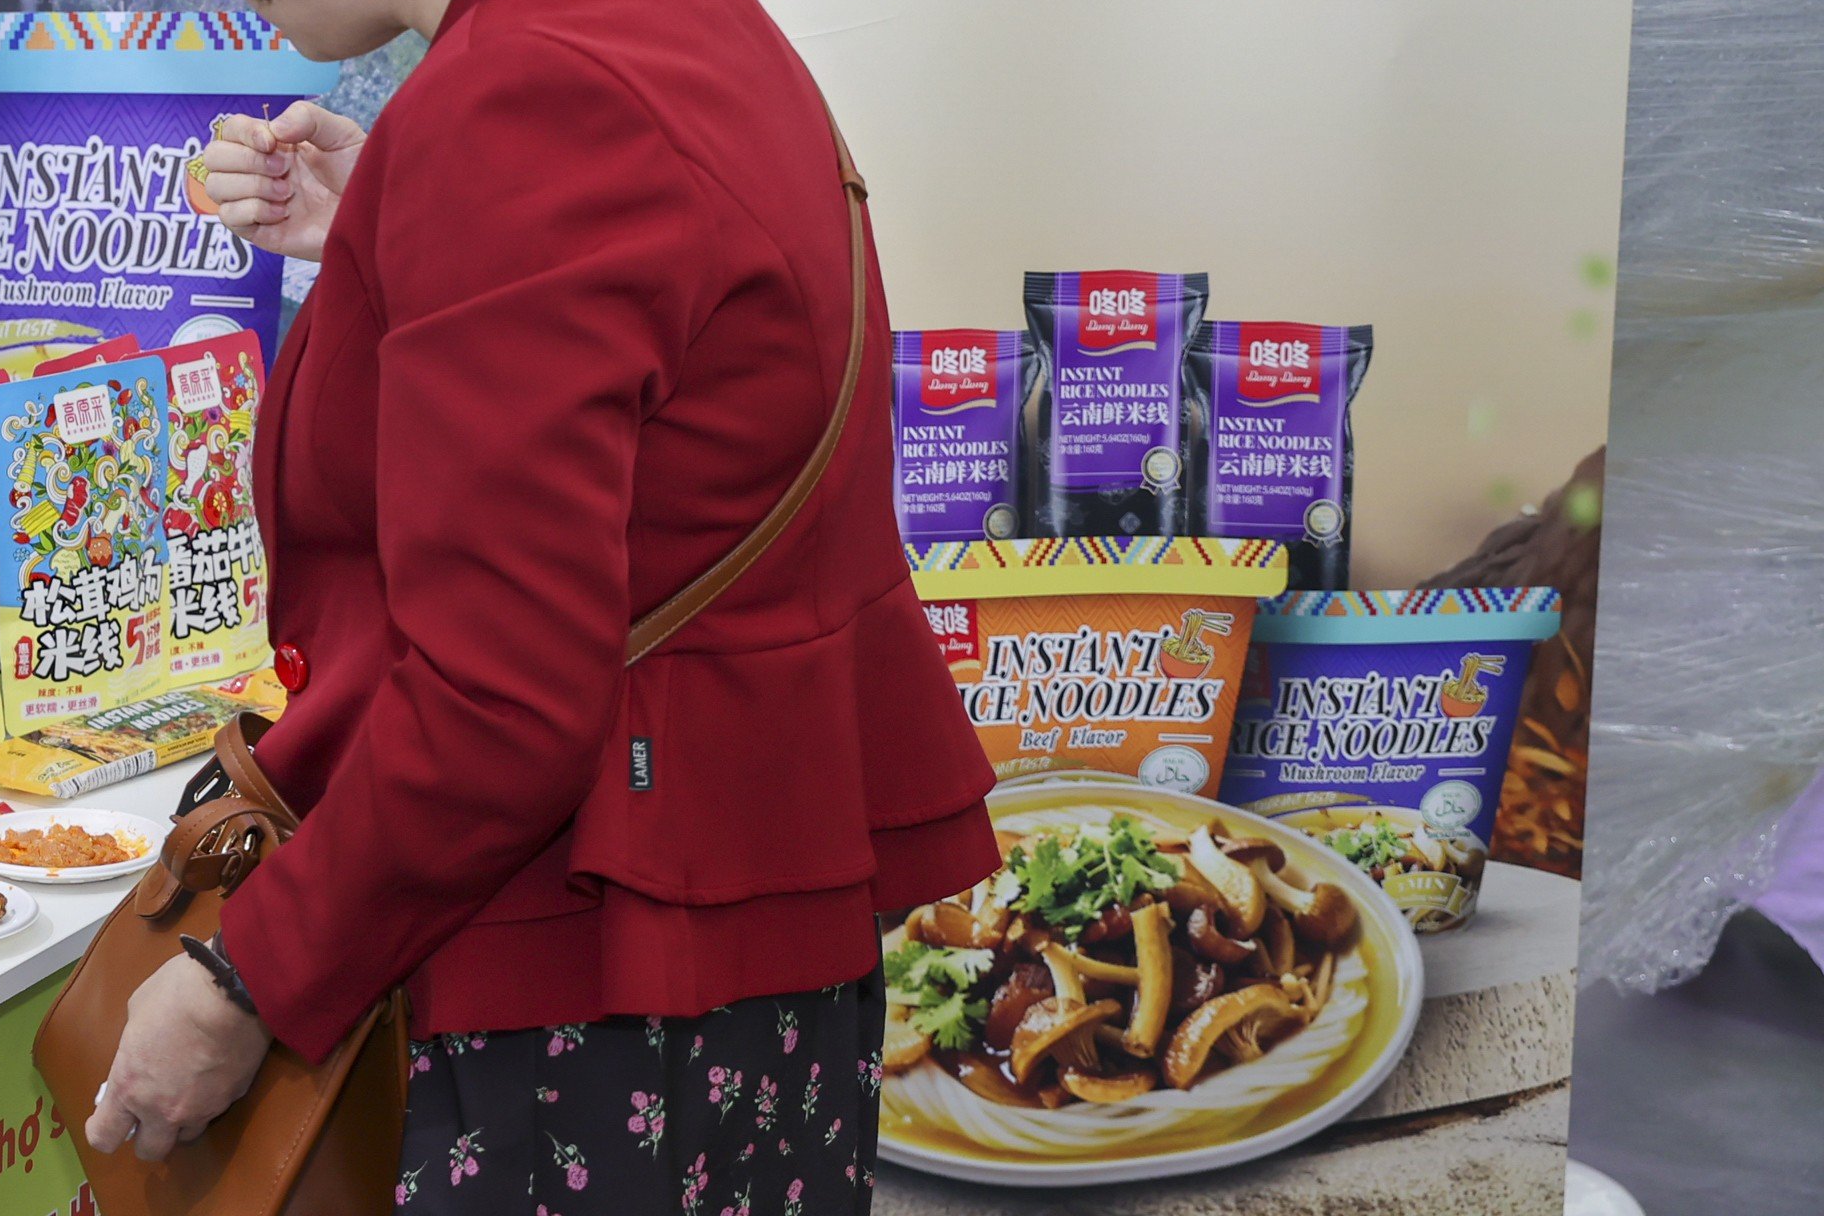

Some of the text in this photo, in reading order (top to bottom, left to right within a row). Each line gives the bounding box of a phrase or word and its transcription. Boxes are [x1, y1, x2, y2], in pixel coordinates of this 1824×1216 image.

[14, 209, 253, 280] NOODLES
[98, 277, 173, 310] Flavor
[1088, 287, 1146, 317] 咚咚
[931, 346, 987, 376] 咚咚
[1250, 339, 1311, 370] 咚咚
[177, 367, 212, 397] 高原采
[1060, 366, 1124, 382] INSTANT
[1060, 382, 1170, 399] RICE NOODLES
[62, 395, 106, 426] 高原采
[1061, 401, 1170, 426] 云南鲜米线
[1218, 416, 1286, 433] INSTANT
[903, 425, 965, 441] INSTANT
[1218, 433, 1334, 452] RICE NOODLES
[902, 441, 1009, 458] RICE NOODLES
[902, 459, 1009, 485] 云南鲜米线
[1218, 452, 1334, 479] 云南鲜米线
[24, 550, 164, 626] 松茸鸡汤
[35, 624, 124, 680] 米线
[126, 615, 145, 668] 5
[984, 624, 1174, 680] INSTANT
[956, 678, 1226, 726] ICE NOODLES
[1275, 670, 1455, 721] INSTANT
[86, 702, 156, 730] INSTANT
[129, 698, 206, 731] NOODLES
[1019, 724, 1127, 754] Beef Flavor
[1309, 715, 1498, 762] NOODLES
[1279, 761, 1426, 784] Mushroom Flavor
